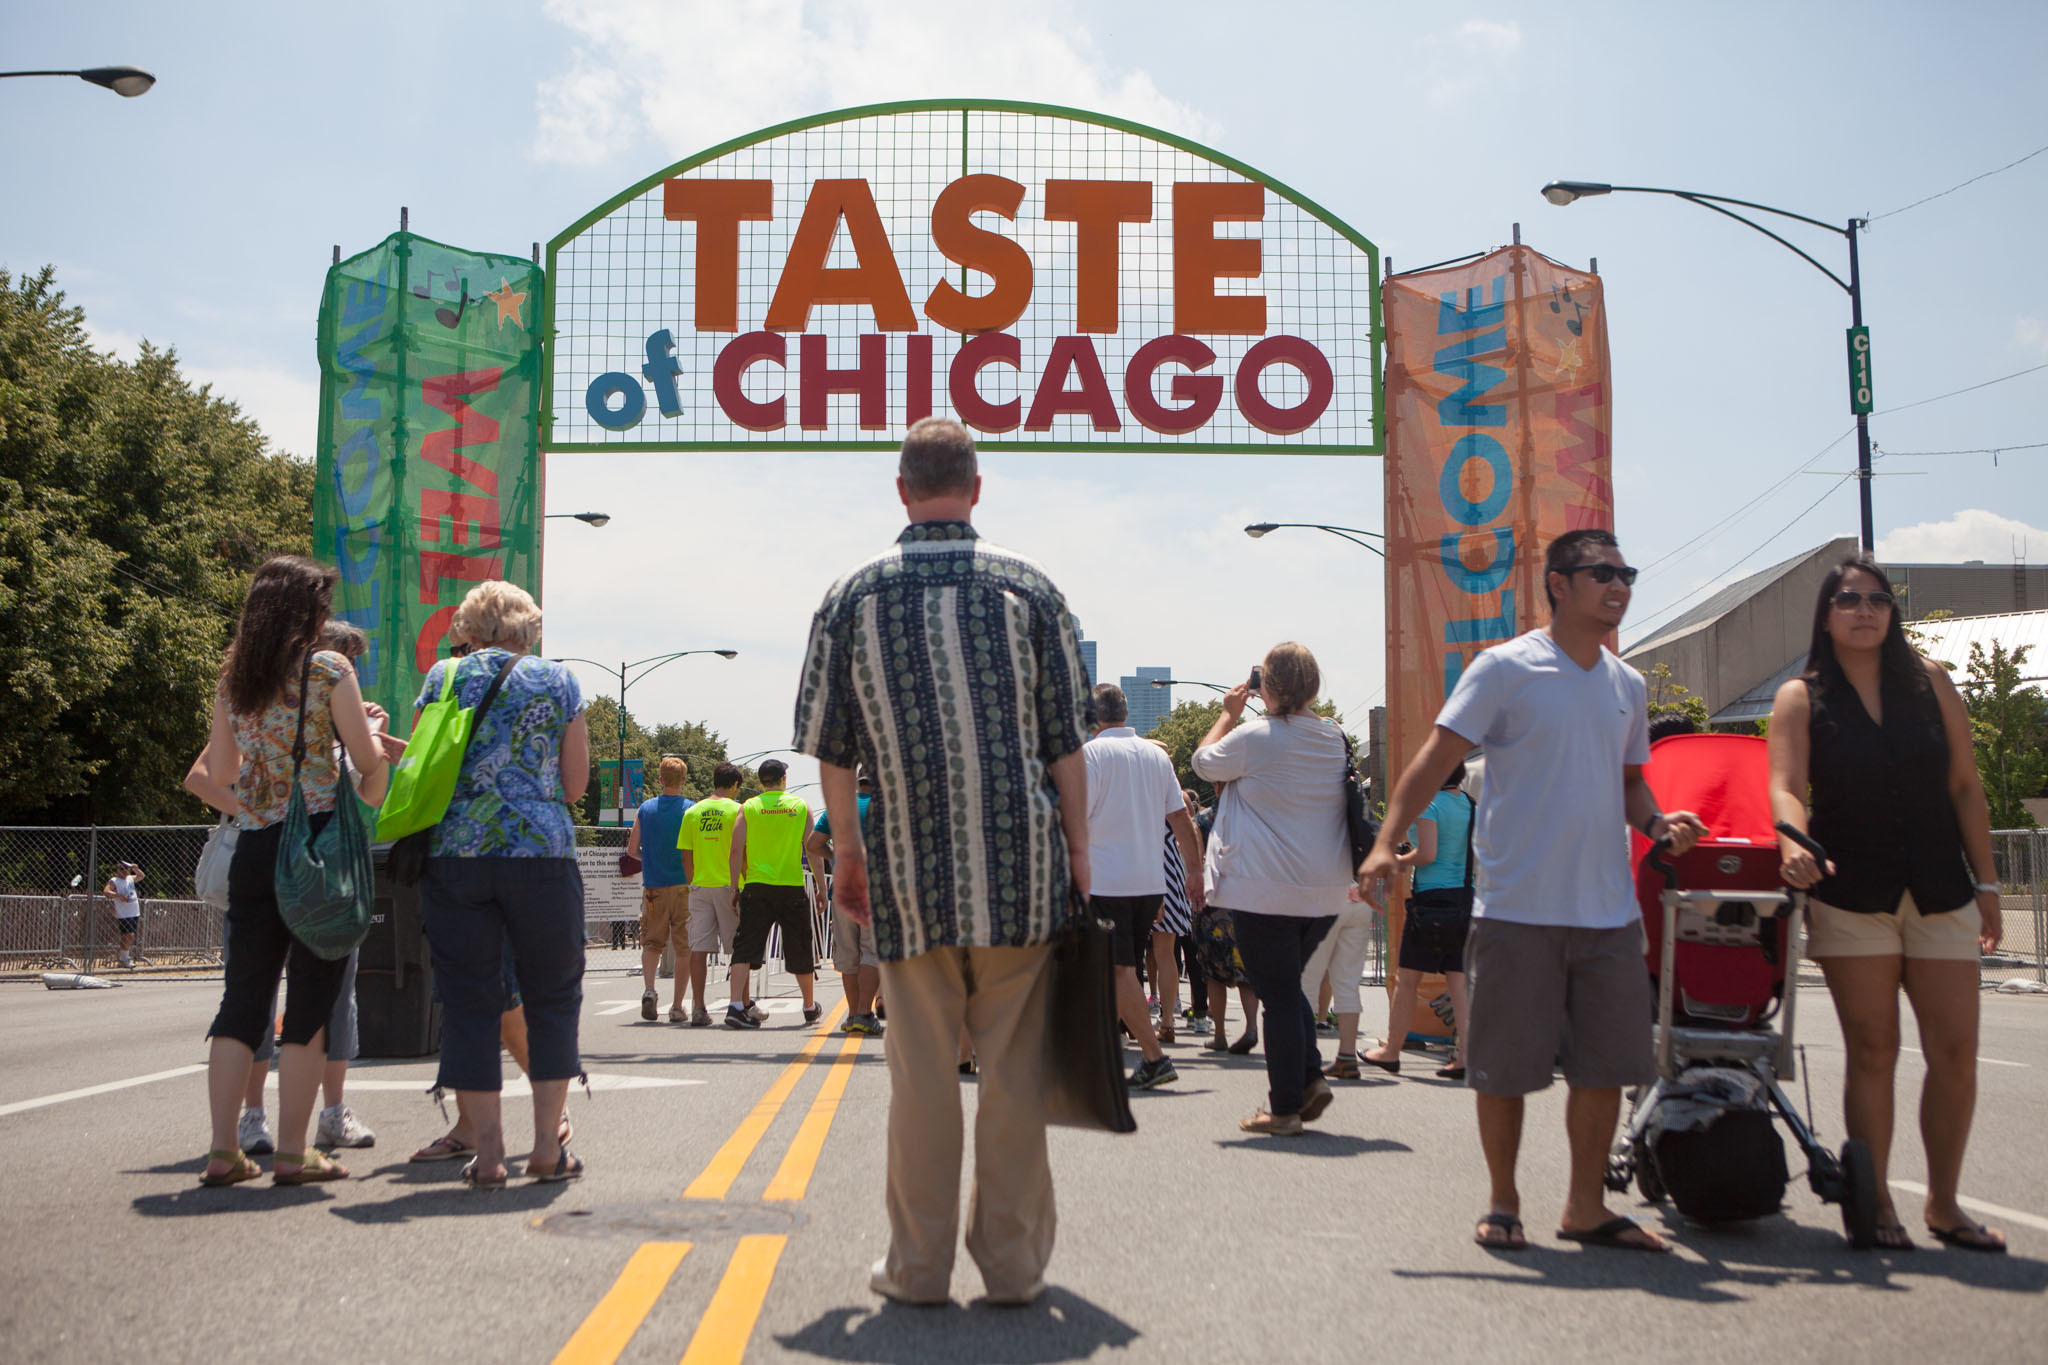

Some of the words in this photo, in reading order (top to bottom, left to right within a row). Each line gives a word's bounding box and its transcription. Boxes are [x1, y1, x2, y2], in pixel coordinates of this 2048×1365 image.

[663, 173, 1267, 336] TASTE
[586, 329, 685, 431] of
[713, 331, 1334, 435] CHICAGO
[1853, 334, 1871, 404] C110
[589, 850, 608, 858] Chicago
